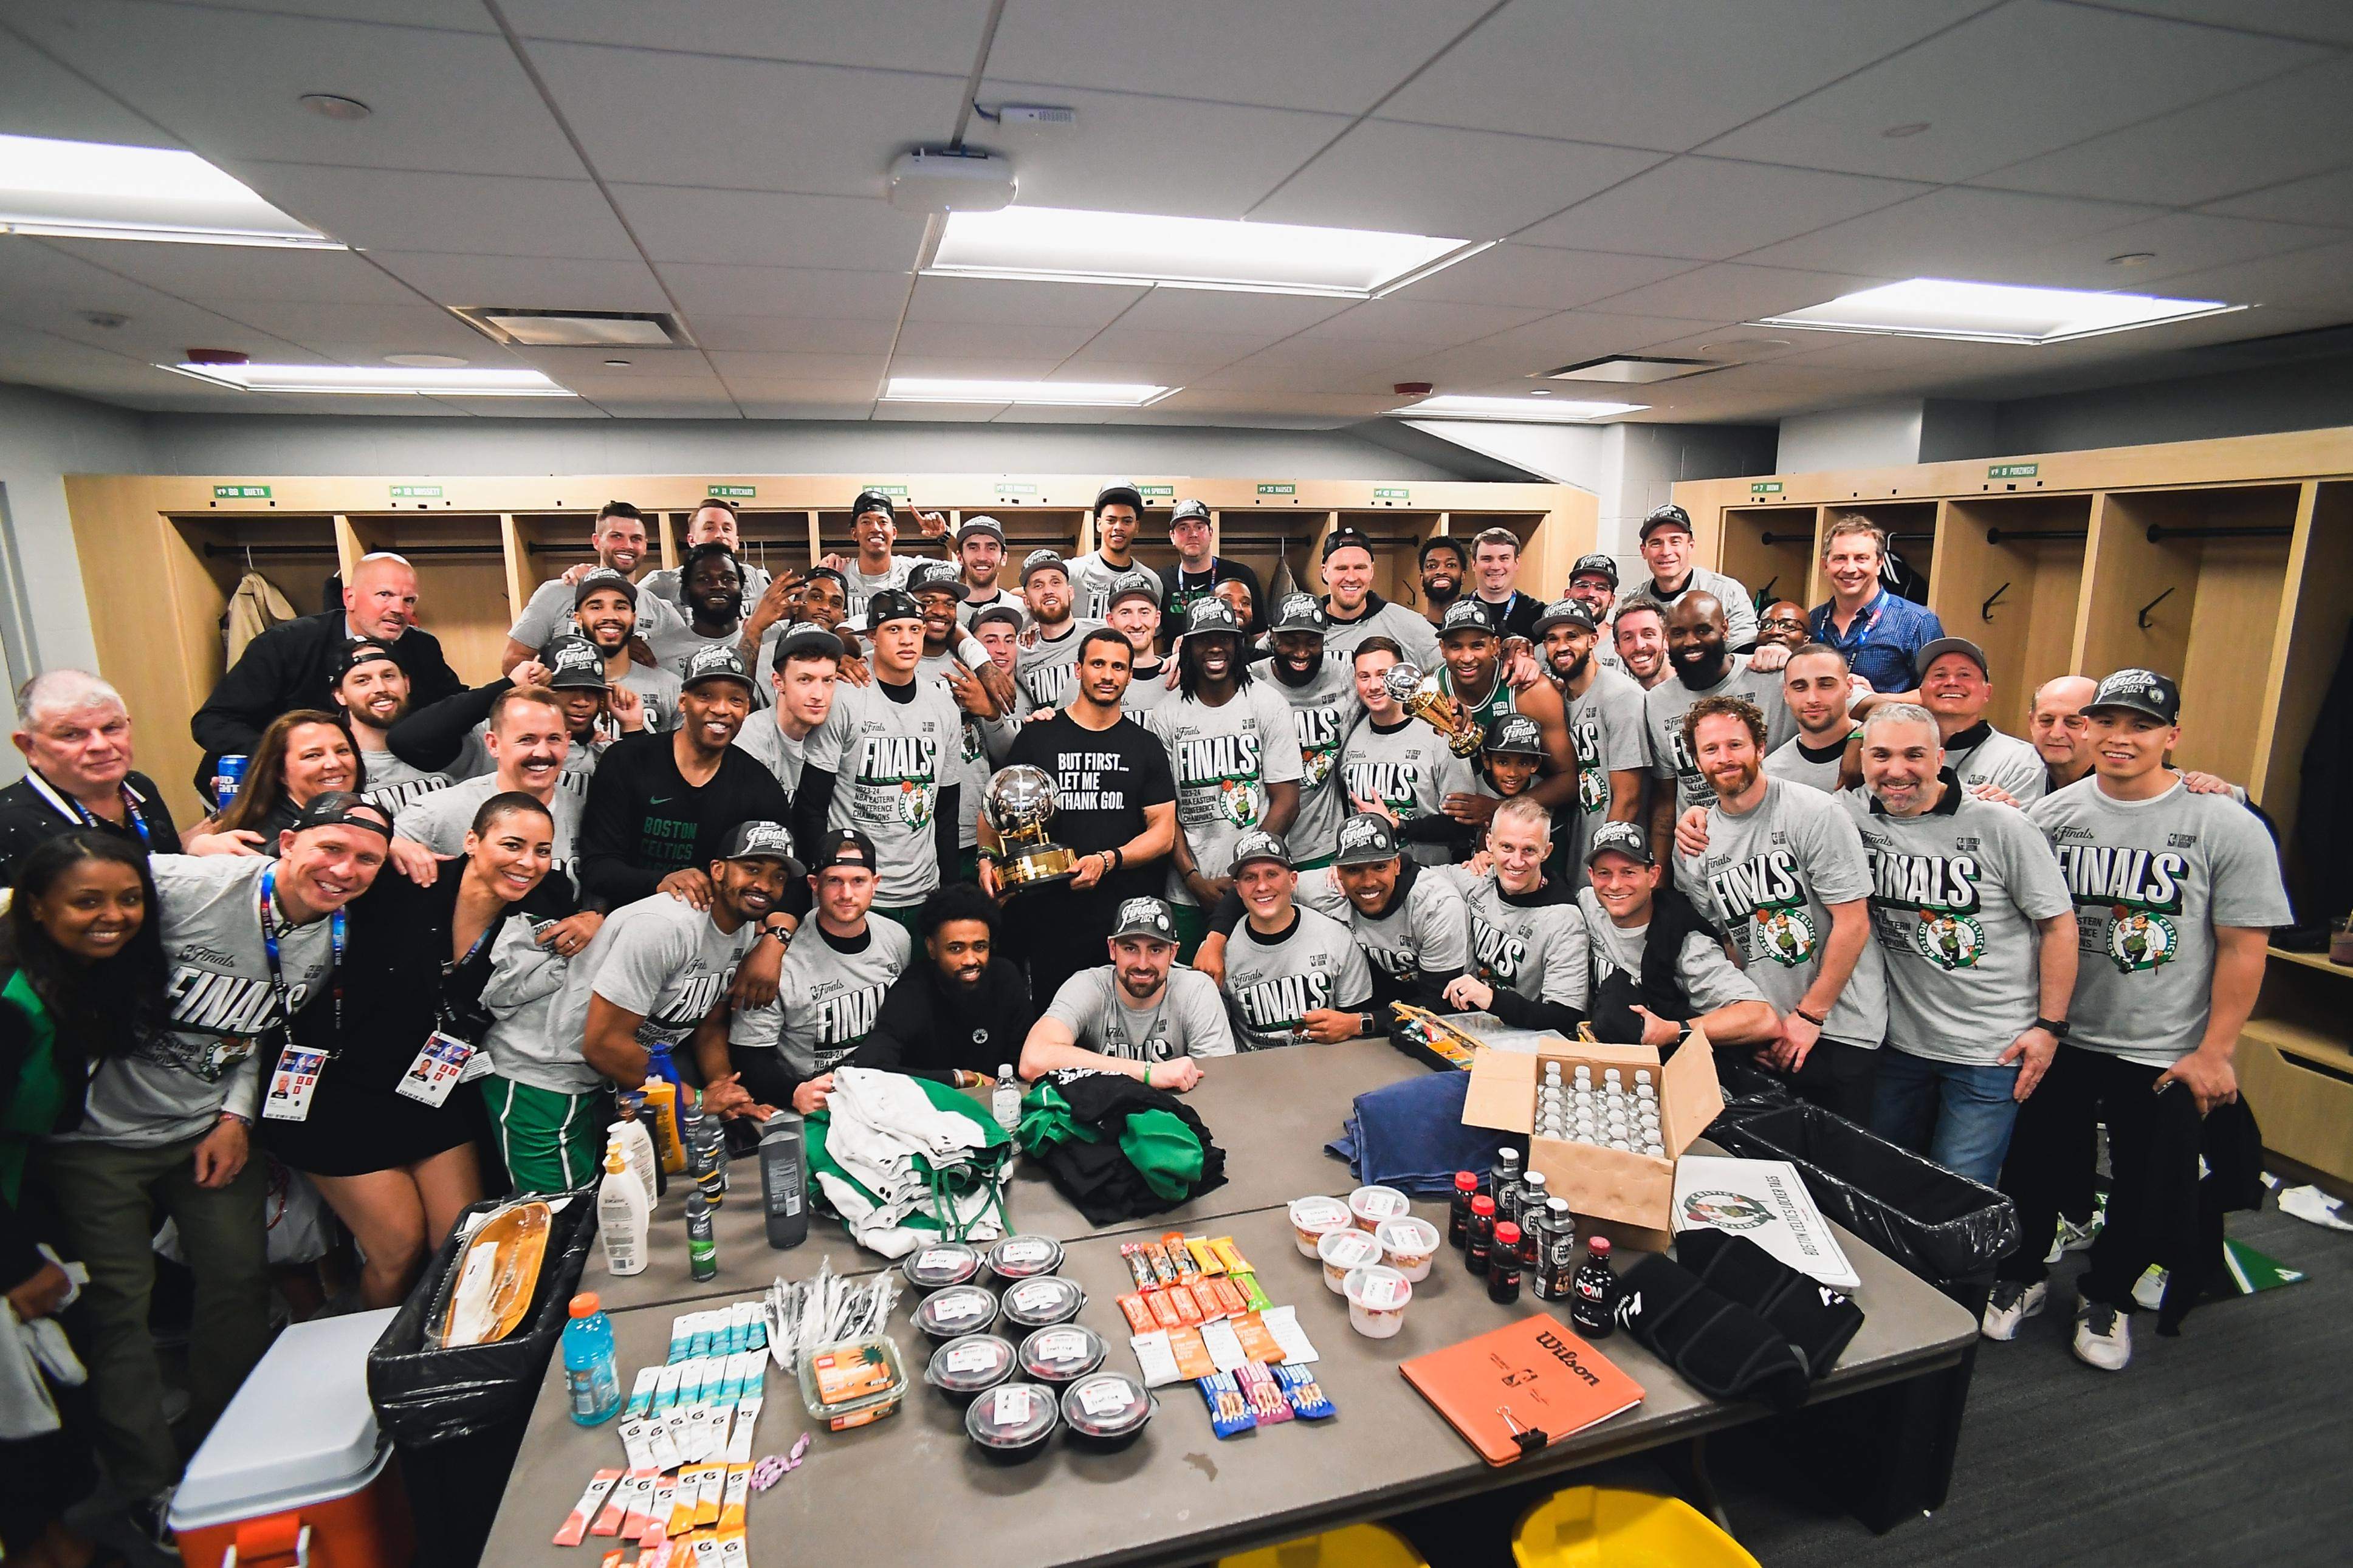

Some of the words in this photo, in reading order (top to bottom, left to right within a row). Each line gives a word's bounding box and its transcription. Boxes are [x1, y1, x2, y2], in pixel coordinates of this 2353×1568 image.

[2121, 685, 2145, 694] 2024
[1492, 701, 1508, 710] VISTA
[1497, 722, 1537, 748] Finals
[857, 736, 936, 779] FINALS
[1057, 753, 1082, 770] BUT
[1177, 733, 1258, 781] FINALS
[856, 786, 879, 794] 2023-24
[1059, 772, 1080, 790] LET
[1082, 772, 1101, 790] ME
[1347, 763, 1414, 801] FINALS
[853, 802, 893, 812] CONFERENCE
[1057, 792, 1098, 810] THANK
[1101, 792, 1124, 809] GOD.
[1192, 795, 1216, 803] EASTERN
[853, 810, 890, 821] CHAMPIONS
[1183, 813, 1213, 822] CHAMPIONS
[644, 817, 698, 839] BOSTON
[1339, 820, 1378, 857] Finals
[2058, 826, 2094, 841] Finals
[642, 839, 693, 860] CELTICS
[1118, 899, 1162, 933] Finals
[1140, 914, 1155, 923] 2024
[2076, 917, 2103, 927] STERN
[1793, 911, 1816, 943] CELTICS
[1963, 918, 1984, 950] CELTICS
[2159, 918, 2176, 956] CELTICS
[1757, 923, 1778, 959] BOSTON
[1918, 922, 1936, 957] BOSTON
[2106, 919, 2118, 957] BOSTON
[189, 947, 233, 967] Finals
[815, 979, 844, 1000] Finals
[1236, 971, 1327, 1025] FINALS
[816, 976, 898, 1044] FINAL
[814, 1060, 830, 1069] NBA
[1771, 1189, 1796, 1208] LOCKER
[1782, 1209, 1807, 1232] CELTICS
[1793, 1233, 1819, 1256] BOSTON
[1536, 1330, 1600, 1386] Wilson
